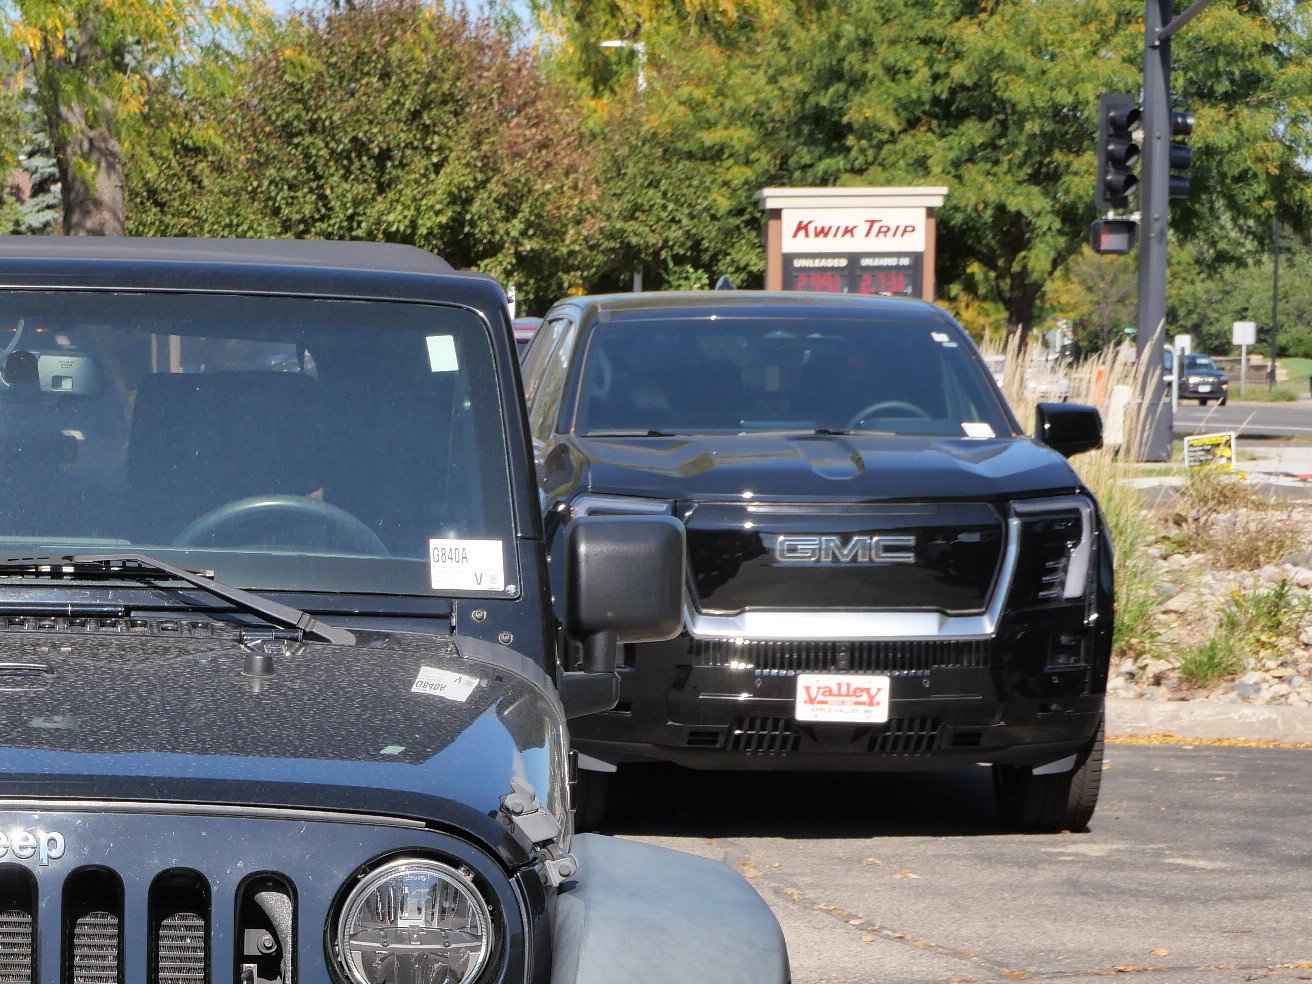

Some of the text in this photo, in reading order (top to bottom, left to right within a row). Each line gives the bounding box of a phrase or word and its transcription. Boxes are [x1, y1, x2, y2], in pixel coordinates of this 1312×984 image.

[792, 219, 916, 239] KWIK TRIP
[792, 257, 848, 268] UNLEADED
[860, 256, 898, 266] UNLEADED
[432, 547, 468, 563] G840A
[775, 535, 916, 563] GMC
[803, 682, 883, 707] Valley
